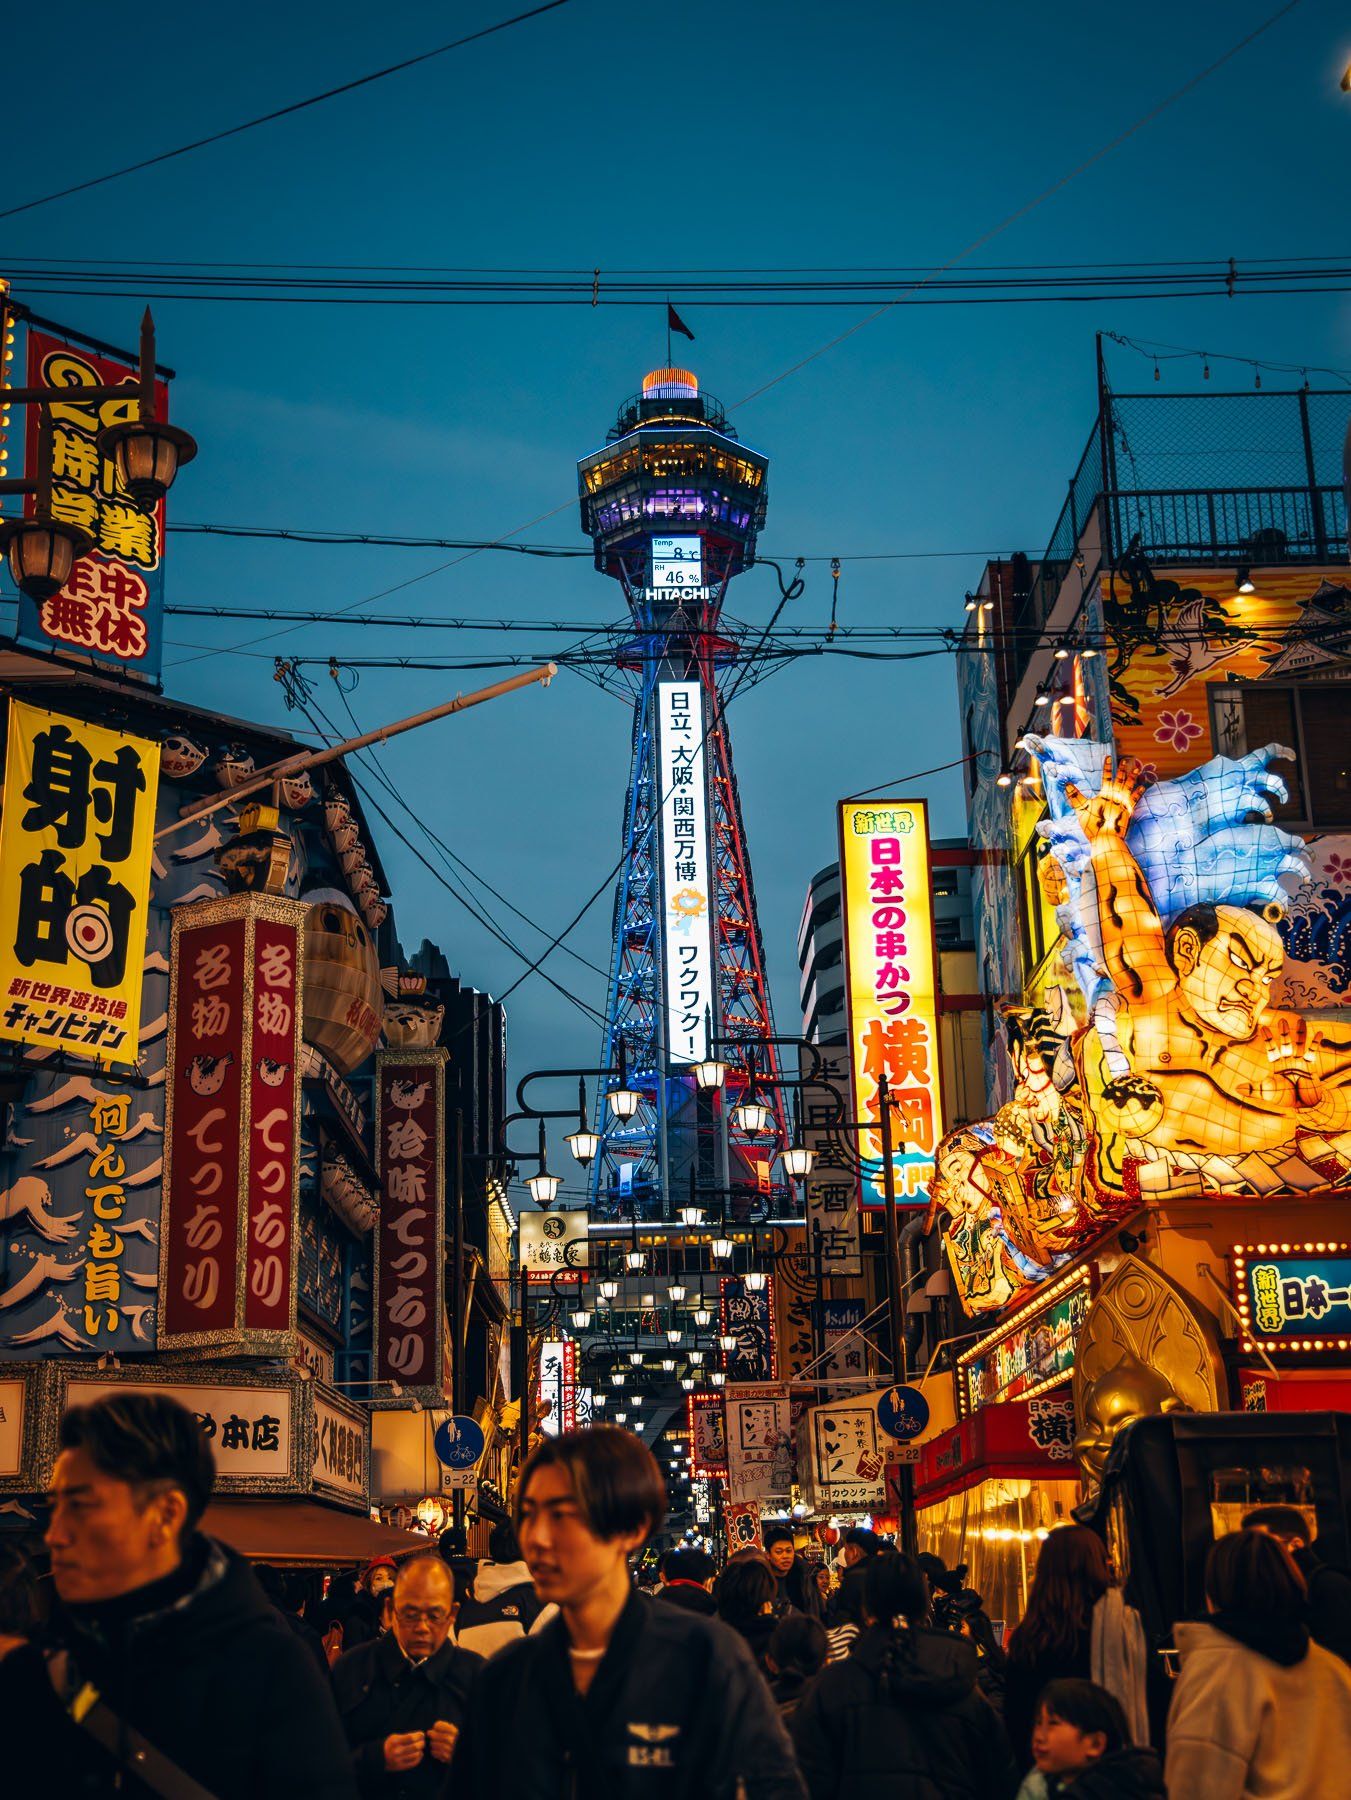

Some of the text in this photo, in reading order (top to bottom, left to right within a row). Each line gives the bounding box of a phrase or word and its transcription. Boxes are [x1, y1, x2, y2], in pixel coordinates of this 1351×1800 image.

[653, 539, 674, 547] Temp
[665, 571, 700, 584] 46 %
[645, 587, 710, 601] HITACHI
[671, 691, 697, 882] 日立、大阪・関西万博
[854, 811, 914, 834] 新世界
[14, 725, 146, 989] 射的
[869, 838, 910, 1016] 日本一の串かつ
[3, 1002, 128, 1049] チャンピオン
[8, 978, 128, 1020] 新世界遊技場
[192, 943, 231, 1039] 名物
[258, 943, 292, 1038] 名物
[679, 945, 701, 1054] ワクワク！
[862, 1018, 935, 1155] 横綱
[1256, 1268, 1281, 1329] 新世界
